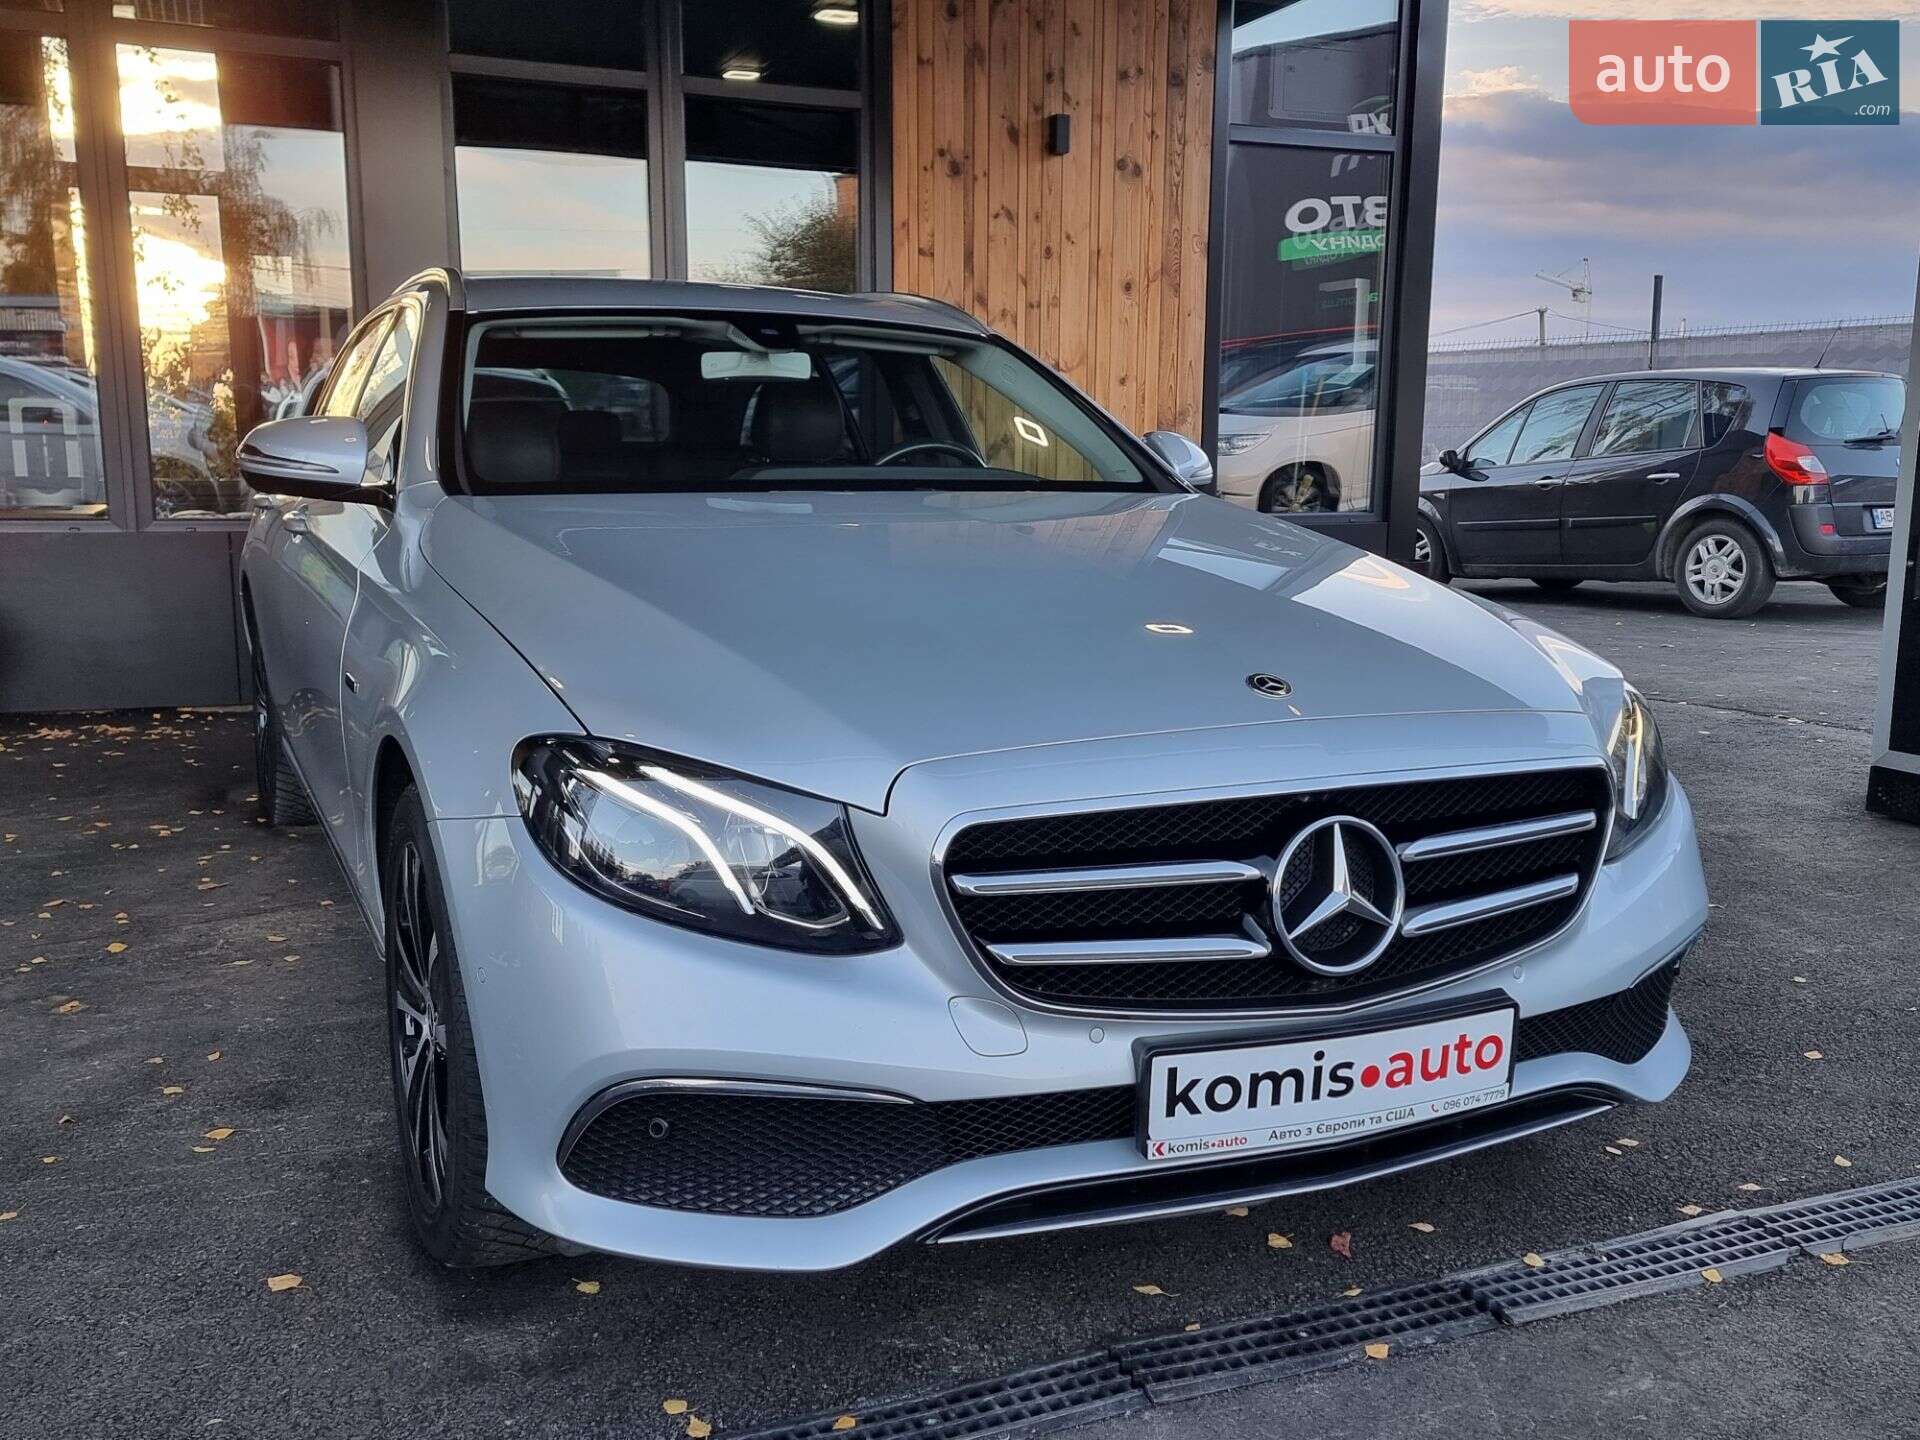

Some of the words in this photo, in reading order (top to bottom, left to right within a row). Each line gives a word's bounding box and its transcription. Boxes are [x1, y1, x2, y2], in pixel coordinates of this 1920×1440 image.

[1268, 1127, 1302, 1142] Авто
[1316, 1118, 1366, 1138] Європи
[1369, 1114, 1383, 1126] та
[1385, 1107, 1416, 1123] США
